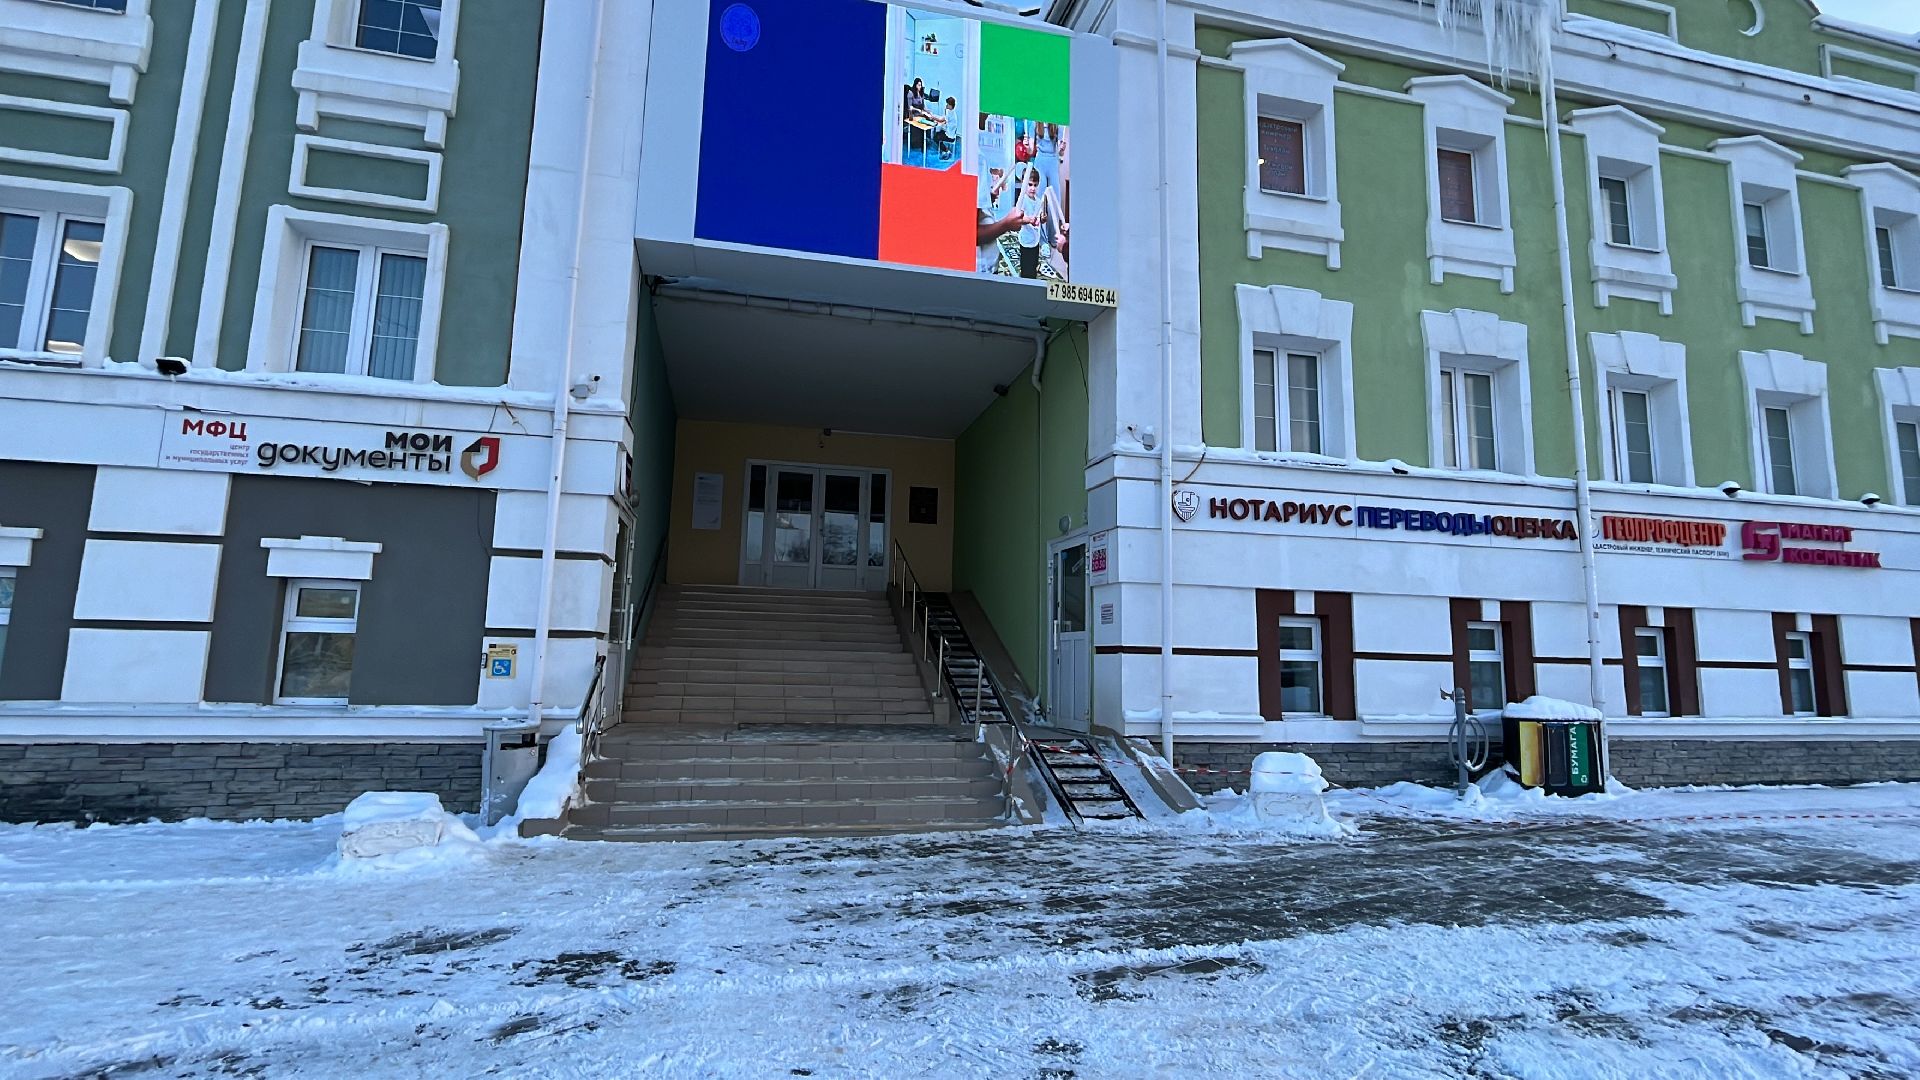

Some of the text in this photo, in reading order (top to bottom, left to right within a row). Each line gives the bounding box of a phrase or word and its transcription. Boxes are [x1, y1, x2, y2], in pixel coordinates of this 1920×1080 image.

[1050, 284, 1116, 304] +7 985 694 65 44
[182, 418, 247, 441] МФЦ
[1209, 497, 1578, 540] НОТАРИУС ПЕРЕВОДЫ ОЦЕНКА
[1602, 515, 1727, 546] ГЕОПРОФЦЕНТР
[1780, 524, 1854, 542] МАГНИТ
[1783, 548, 1881, 568] КОСМЕТИК
[1570, 726, 1579, 775] БУМАГА
